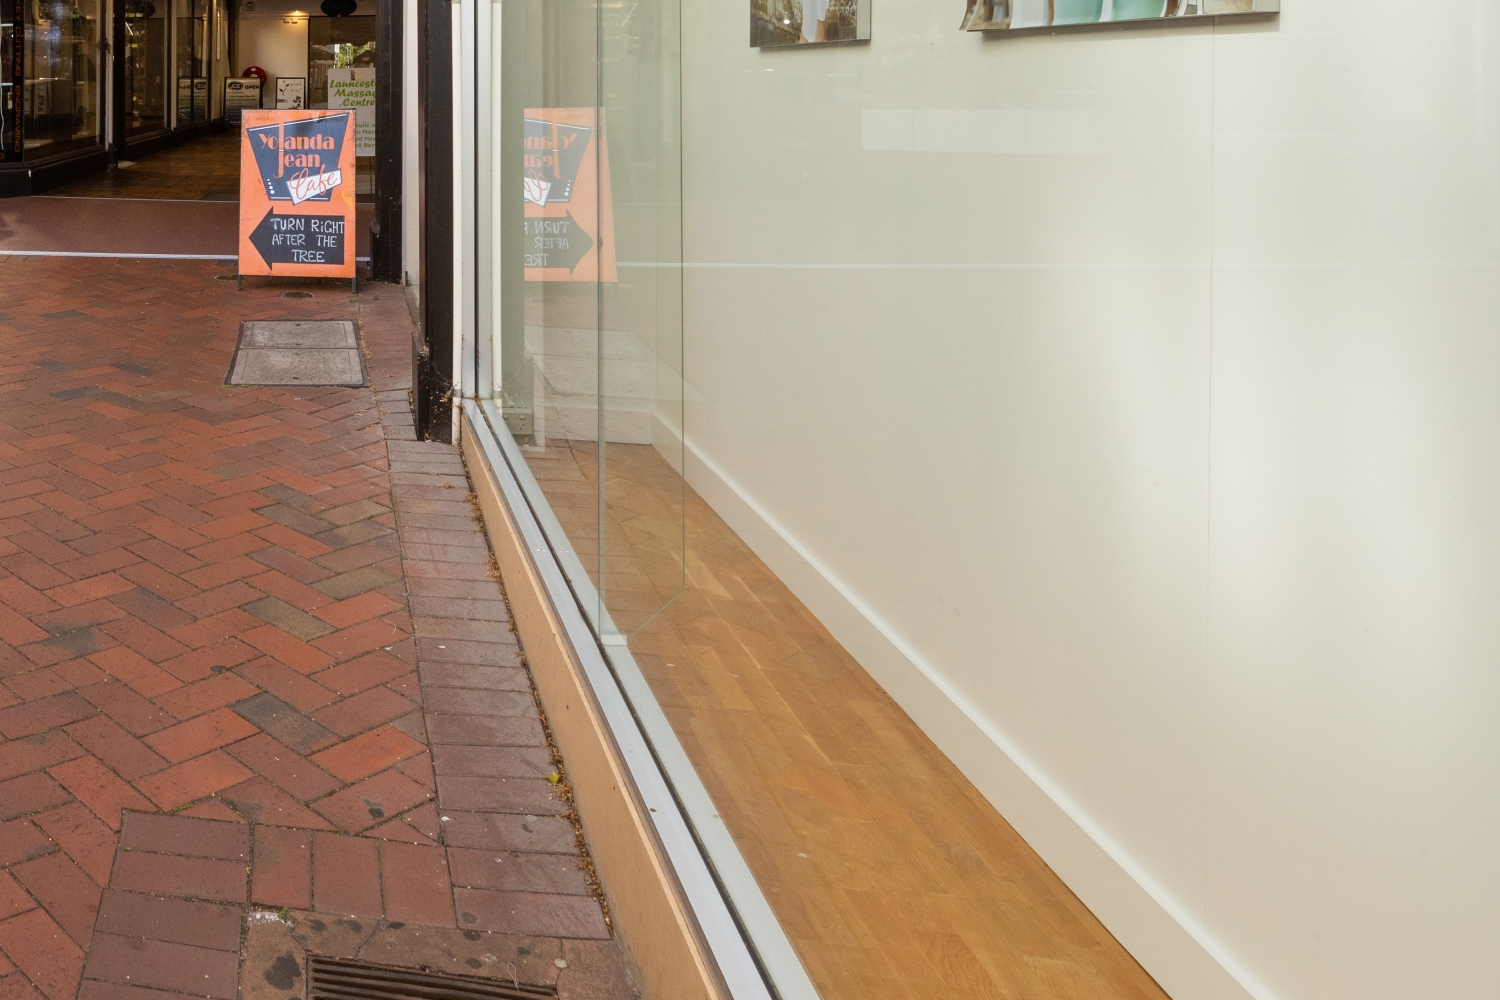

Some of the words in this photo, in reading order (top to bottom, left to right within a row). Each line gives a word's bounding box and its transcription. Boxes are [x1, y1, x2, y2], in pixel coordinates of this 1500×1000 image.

[14, 27, 22, 77] CUTTING
[329, 79, 376, 89] Launcest
[342, 97, 375, 107] Centre
[14, 85, 22, 153] ENGRAVING
[258, 123, 335, 151] Yolanda
[273, 151, 321, 179] Jean
[289, 164, 337, 200] Cafe
[269, 217, 305, 232] TURN
[271, 234, 306, 246] AFTER
[315, 234, 338, 248] THE
[291, 249, 325, 263] TREE
